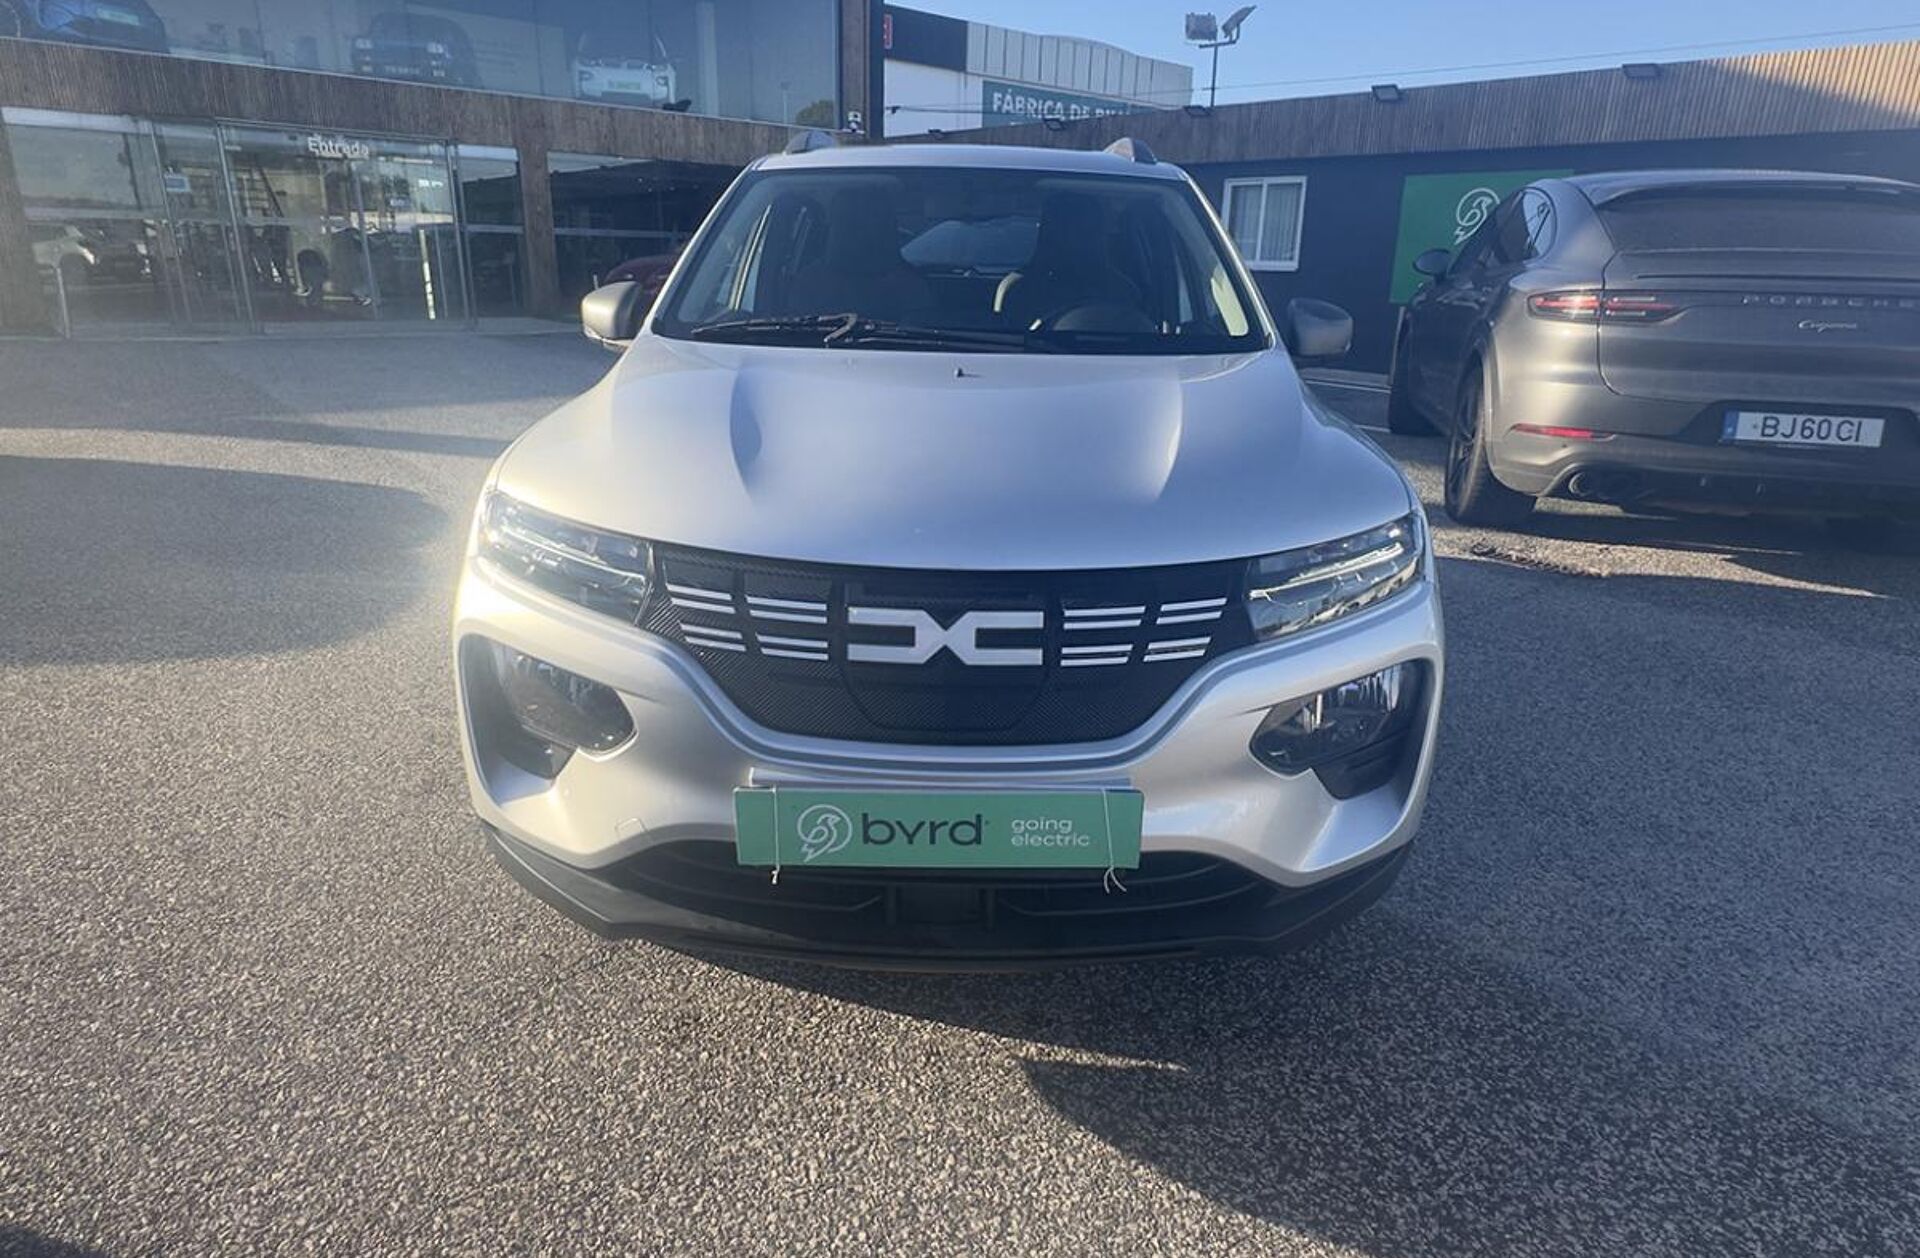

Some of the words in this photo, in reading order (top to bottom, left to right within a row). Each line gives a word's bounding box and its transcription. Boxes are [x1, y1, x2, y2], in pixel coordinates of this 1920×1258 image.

[992, 89, 1066, 121] FÁBRICA
[1069, 103, 1091, 121] DE
[307, 136, 370, 158] Entrada
[1742, 295, 1915, 308] PORSCHE
[861, 812, 983, 846] byrd
[1010, 816, 1073, 834] going
[1010, 832, 1091, 847] electric
